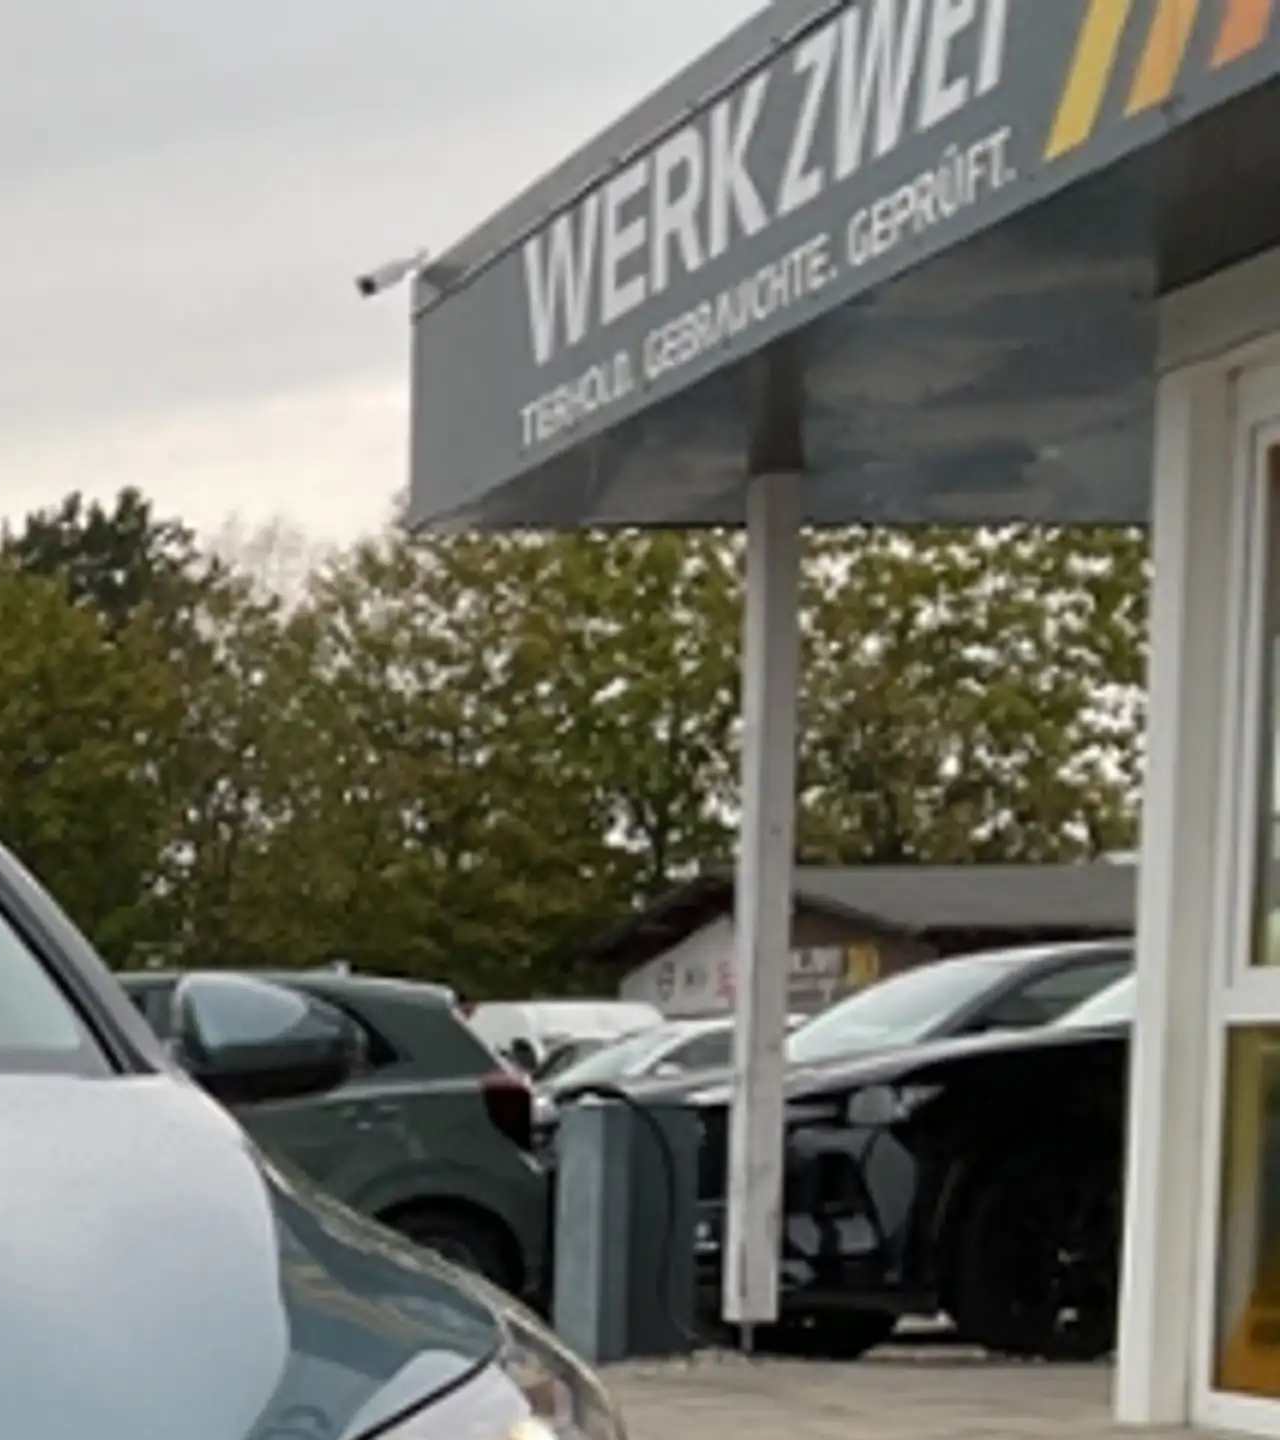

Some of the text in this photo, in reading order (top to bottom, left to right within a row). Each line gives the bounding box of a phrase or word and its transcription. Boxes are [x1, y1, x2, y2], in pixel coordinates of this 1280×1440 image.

[522, 68, 771, 368] WERK
[643, 232, 838, 380] GEBRAUCHTE.
[846, 125, 1018, 268] GEPRÜFT.
